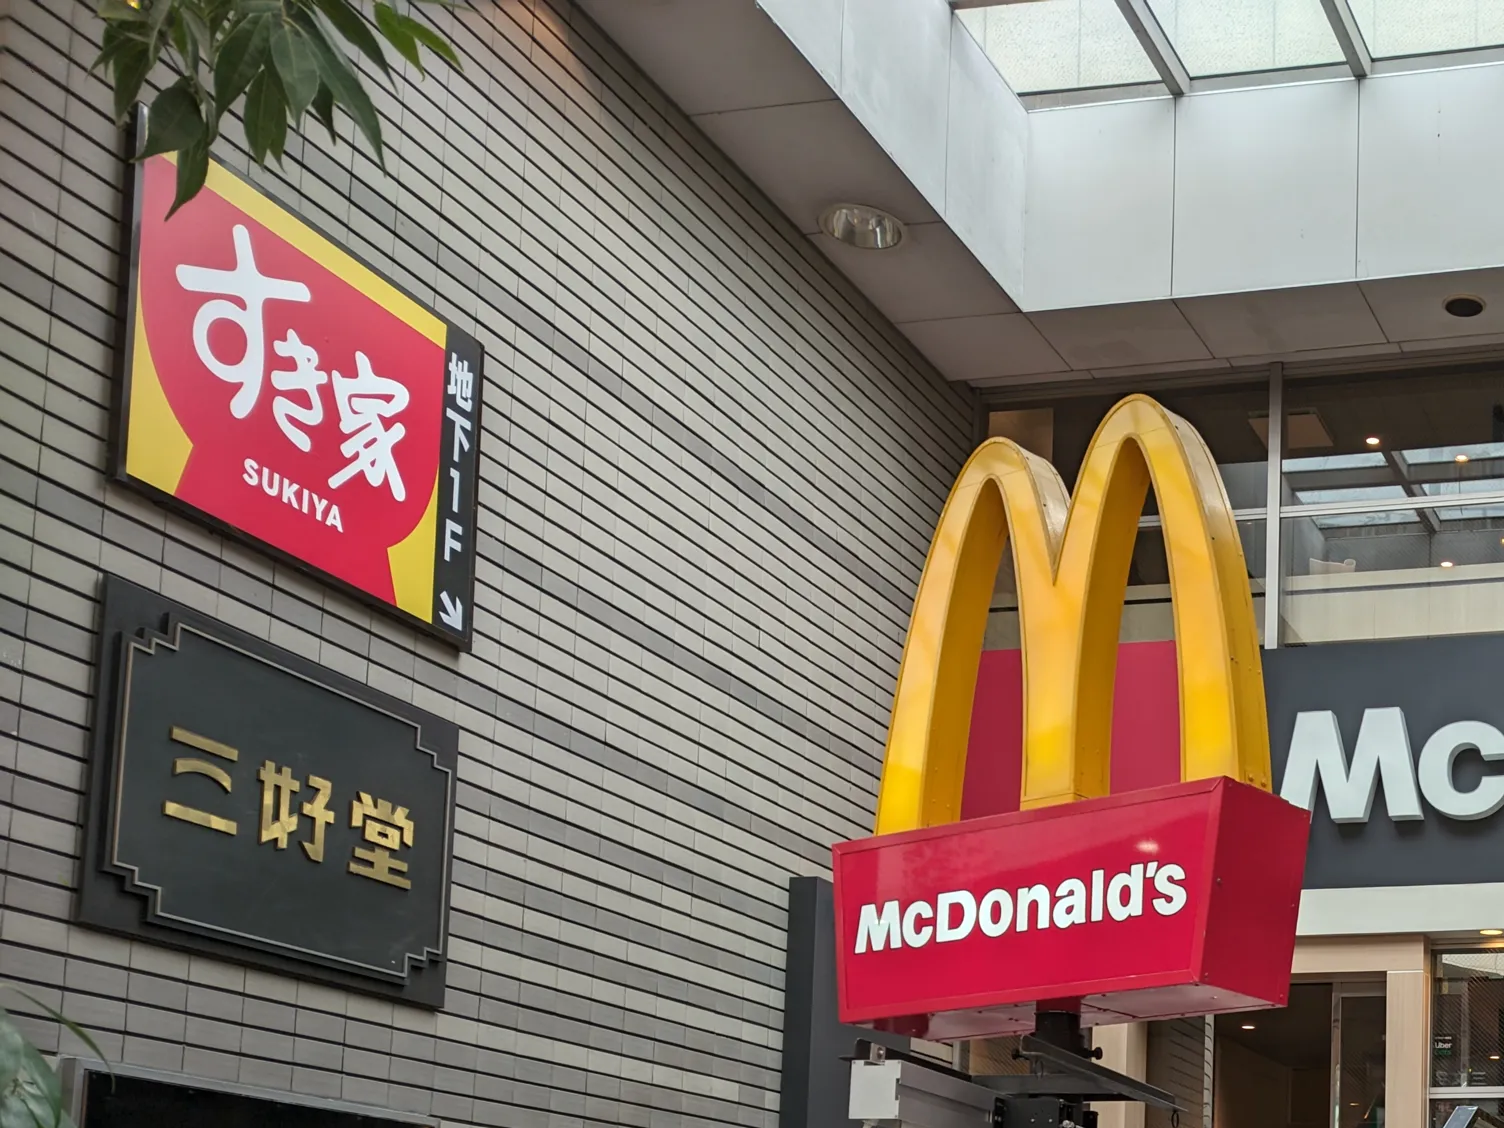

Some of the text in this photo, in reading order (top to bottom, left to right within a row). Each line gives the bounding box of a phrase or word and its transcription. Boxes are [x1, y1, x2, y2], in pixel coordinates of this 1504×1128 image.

[175, 224, 410, 502] すき家
[242, 457, 345, 534] SUKIYA
[440, 351, 475, 563] 地下1F
[162, 725, 415, 891] 三好堂
[854, 860, 1189, 955] McDonald's
